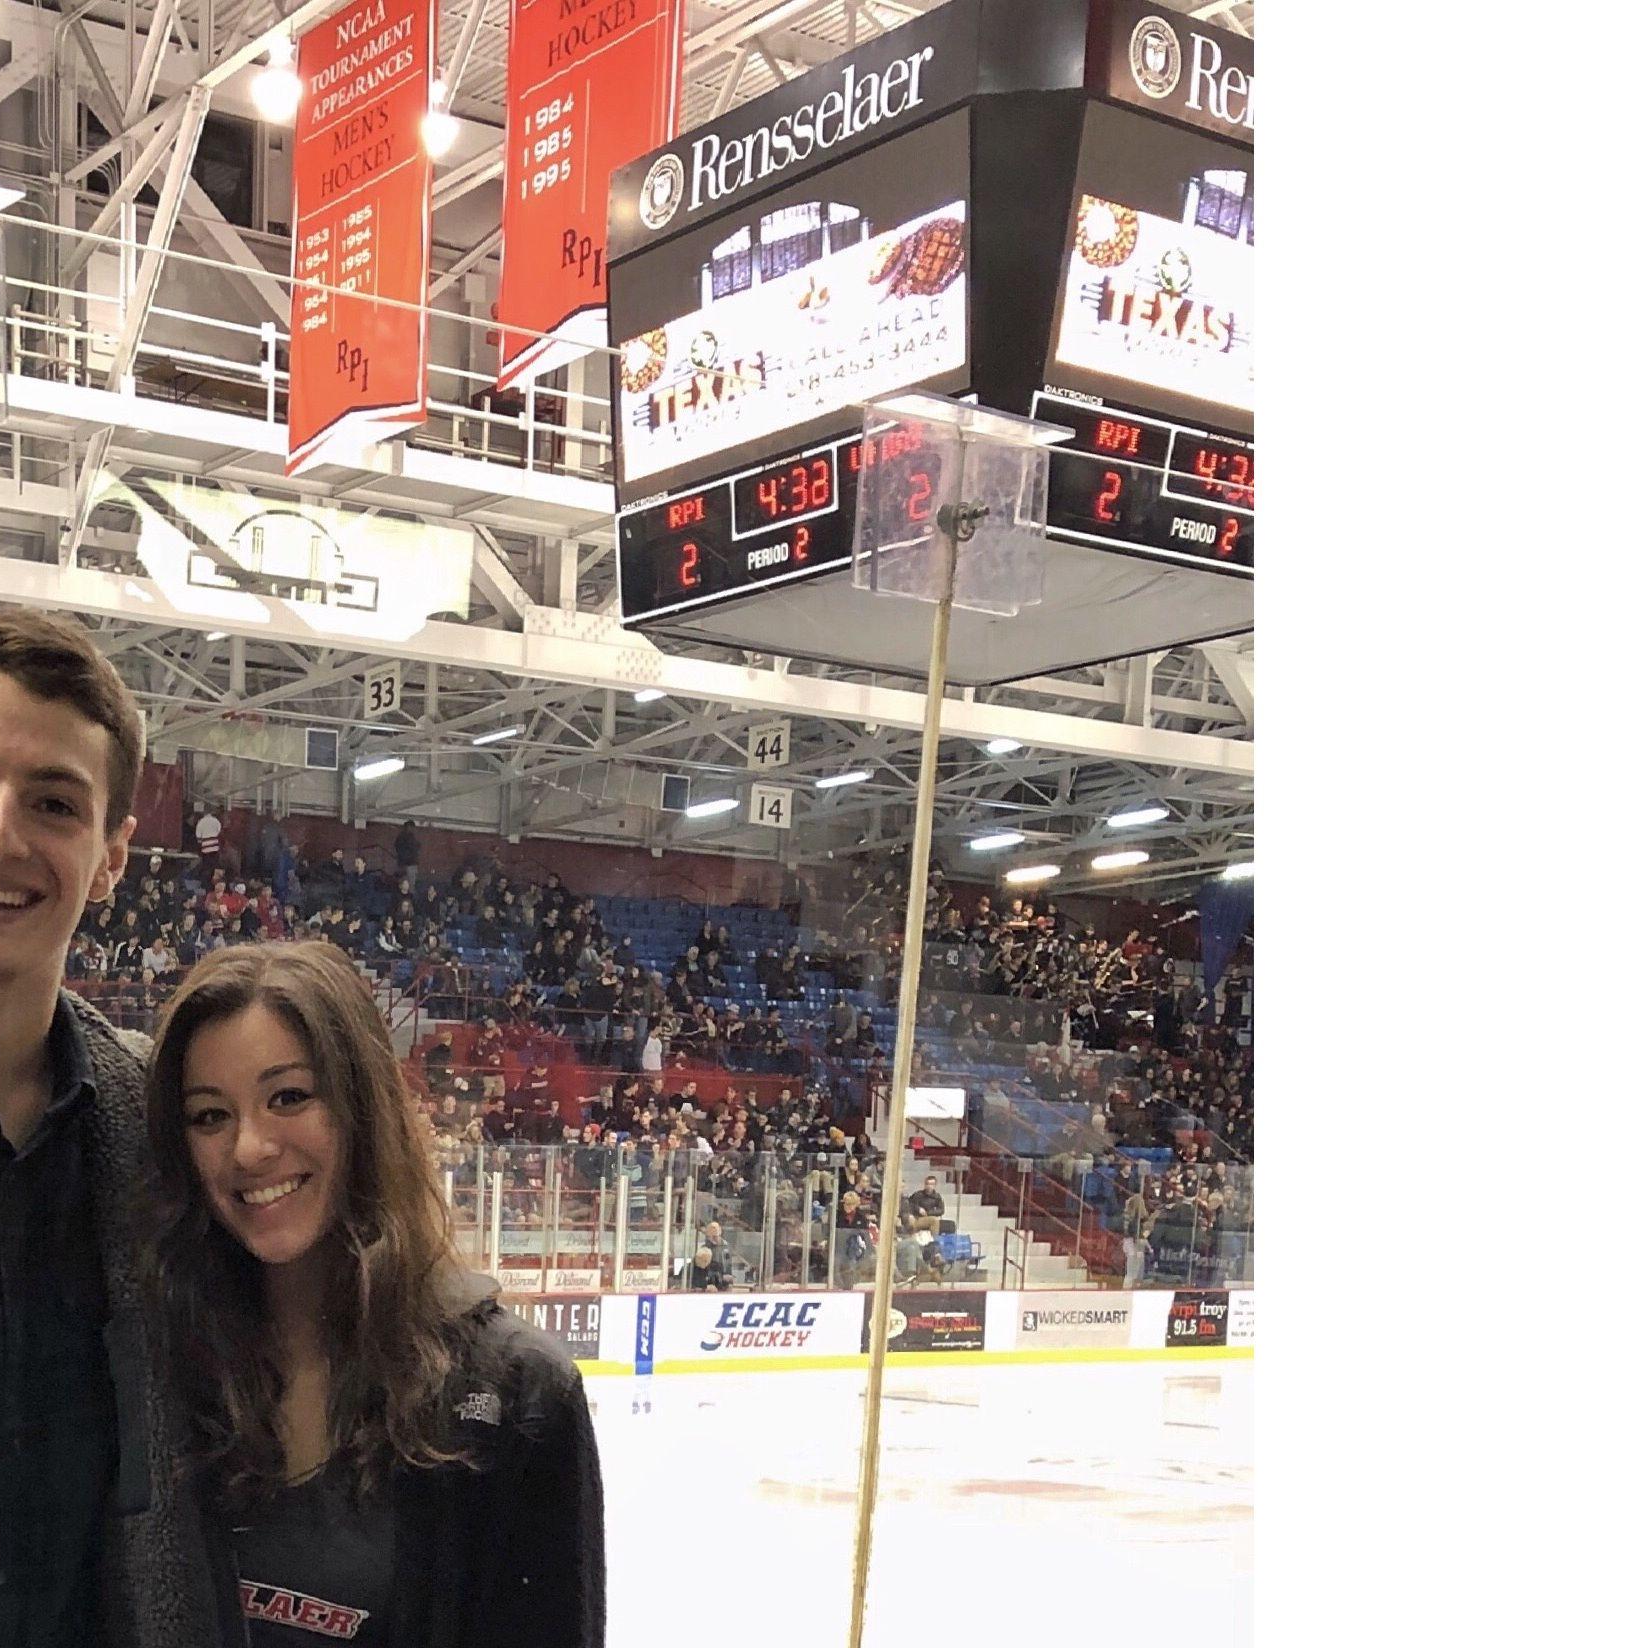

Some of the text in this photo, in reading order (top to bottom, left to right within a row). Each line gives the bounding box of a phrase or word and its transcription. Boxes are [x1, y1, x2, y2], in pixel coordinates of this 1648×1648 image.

[336, 0, 385, 49] NCAA
[547, 0, 637, 68] HOCKEY
[310, 13, 415, 95] TOURNAMENT
[312, 44, 414, 124] APPEARANCES
[333, 100, 389, 156] MEN'S
[524, 92, 574, 137] 1984
[687, 46, 934, 212] Rensselaer
[321, 133, 395, 198] HOCKEY
[523, 124, 572, 168] 1985
[521, 157, 571, 200] 1995
[561, 228, 603, 288] RPI
[336, 339, 370, 392] RPI
[1044, 384, 1103, 407] DAKTRONICS
[1099, 419, 1143, 454] RPI
[667, 496, 706, 530] RPI
[908, 472, 931, 521] 2
[1097, 471, 1122, 521] 2
[747, 526, 810, 571] PERIOD 2
[1170, 516, 1240, 551] PERIOD 2
[680, 542, 698, 586] 2
[370, 676, 395, 711] 33
[754, 734, 785, 764] 44
[759, 796, 784, 823] 14
[640, 1300, 651, 1357] CCM
[715, 1302, 822, 1328] ECAC
[1039, 1310, 1128, 1325] WICKEDSMART
[1174, 1319, 1197, 1336] 91.5
[1199, 1318, 1217, 1336] fm
[1200, 1301, 1227, 1320] troy
[725, 1331, 811, 1348] HOCKEY
